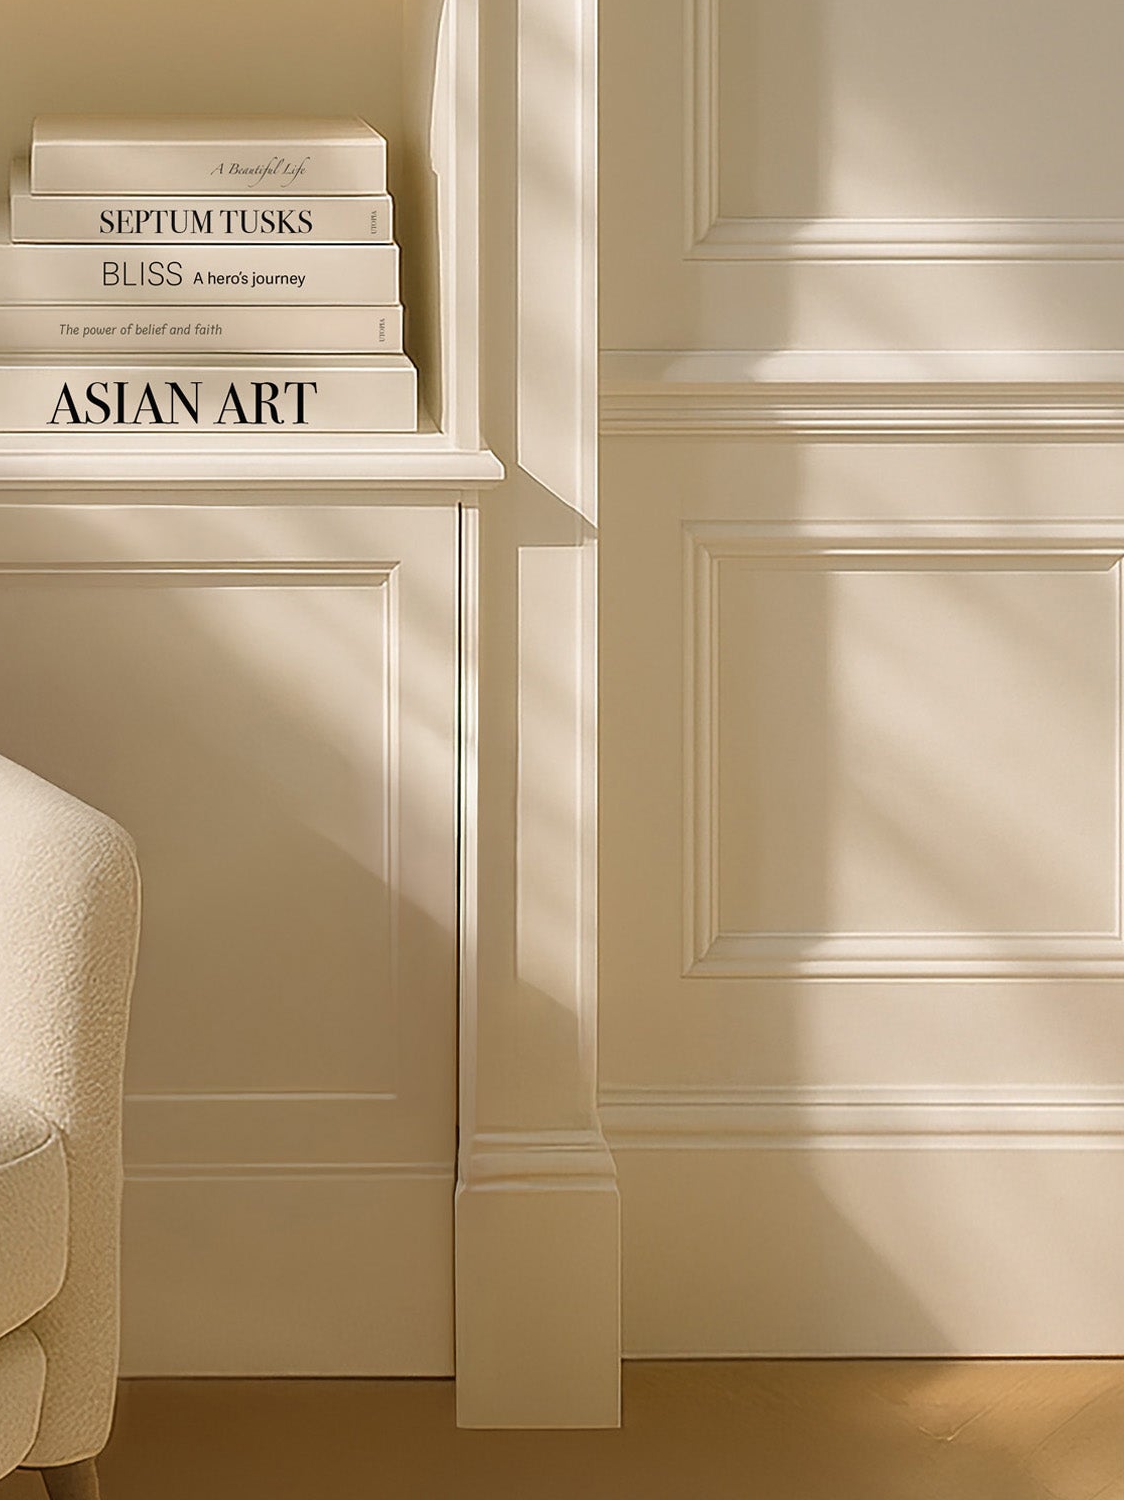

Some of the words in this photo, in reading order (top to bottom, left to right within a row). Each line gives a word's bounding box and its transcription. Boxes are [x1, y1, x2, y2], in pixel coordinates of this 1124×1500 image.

[210, 162, 224, 176] A
[228, 156, 285, 188] Beautiful
[280, 156, 311, 188] Life
[99, 209, 214, 234] SEPTUM
[219, 209, 313, 234] TUSKS
[102, 261, 183, 287] BLISS
[192, 271, 204, 285] A
[207, 270, 249, 285] hero's
[250, 271, 306, 289] journey
[59, 323, 80, 336] The
[82, 326, 118, 339] power
[119, 322, 134, 336] of
[135, 322, 169, 336] belief
[169, 323, 191, 336] and
[194, 322, 223, 336] faith
[45, 381, 204, 425] ASIAN
[212, 381, 318, 425] ART
